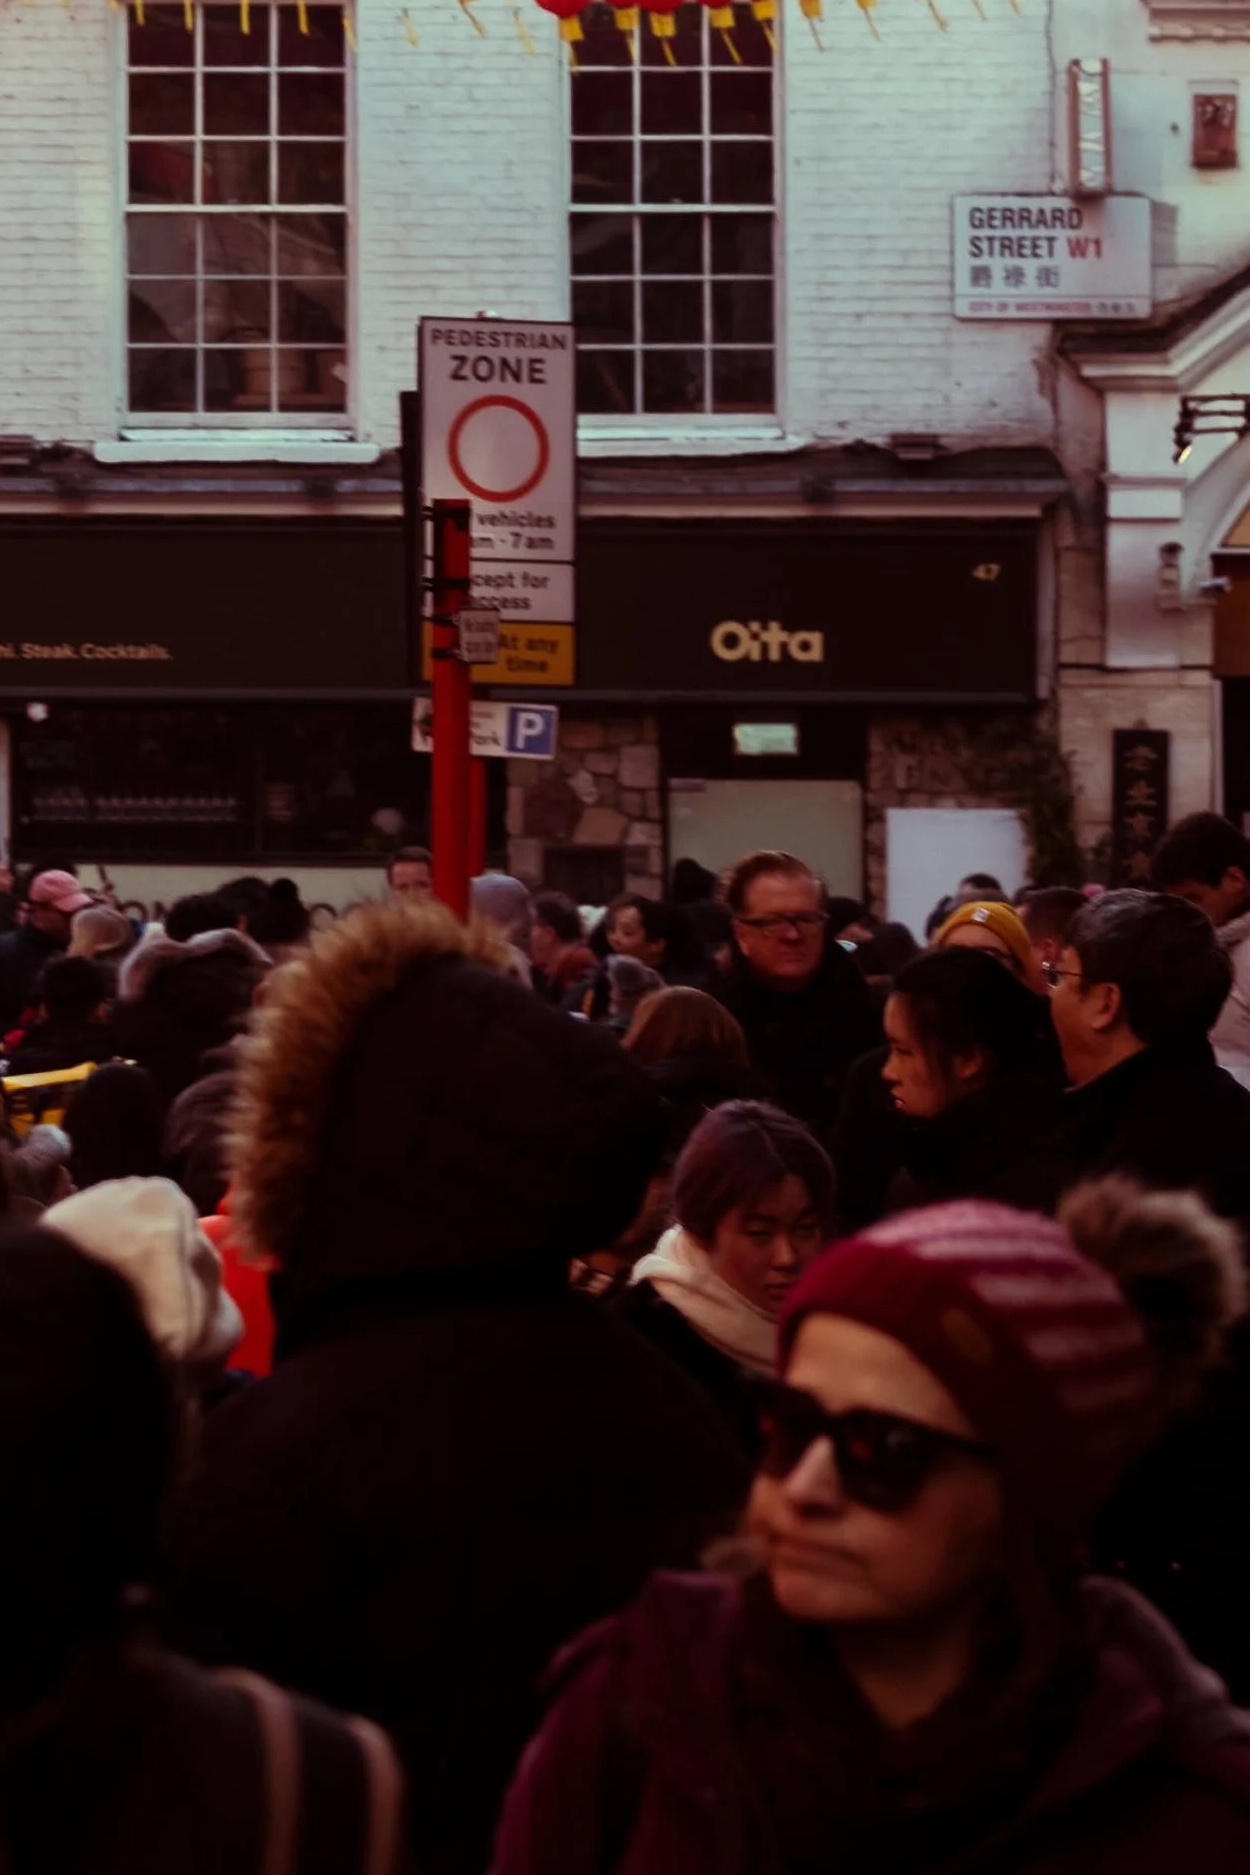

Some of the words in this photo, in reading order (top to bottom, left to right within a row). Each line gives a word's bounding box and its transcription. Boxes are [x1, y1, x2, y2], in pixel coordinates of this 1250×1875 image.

[969, 206, 1084, 231] GERRARD
[969, 235, 1058, 259] STREET
[1066, 236, 1103, 259] W1
[430, 328, 567, 351] PEDESTRIAN
[449, 353, 547, 385] ZONE
[477, 510, 556, 528] vehicles
[521, 571, 550, 589] for
[525, 637, 559, 656] any
[709, 618, 825, 663] Oita
[505, 656, 549, 674] time
[515, 711, 545, 750] P
